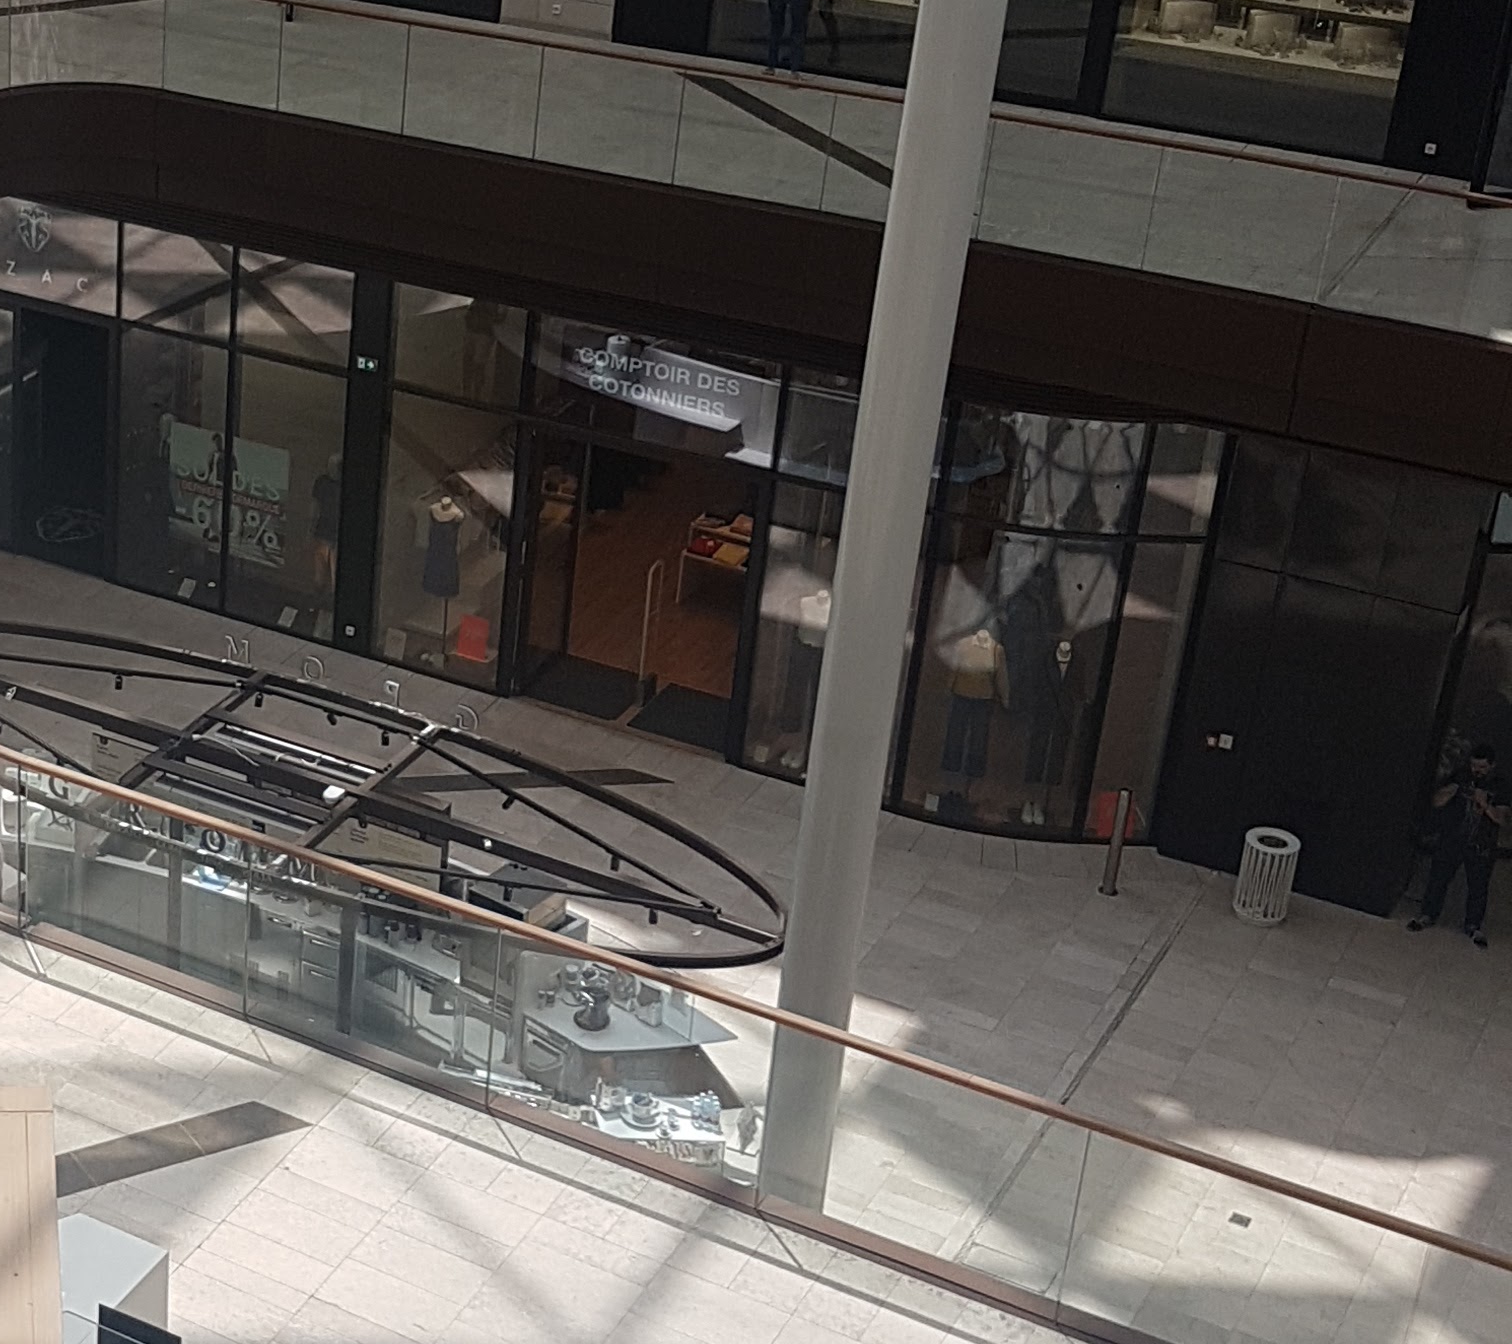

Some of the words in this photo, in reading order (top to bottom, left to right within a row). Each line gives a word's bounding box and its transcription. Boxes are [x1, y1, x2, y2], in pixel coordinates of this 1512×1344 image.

[580, 347, 691, 385] COMPTOIR
[697, 372, 740, 396] DES
[588, 373, 726, 418] COTONNIERS
